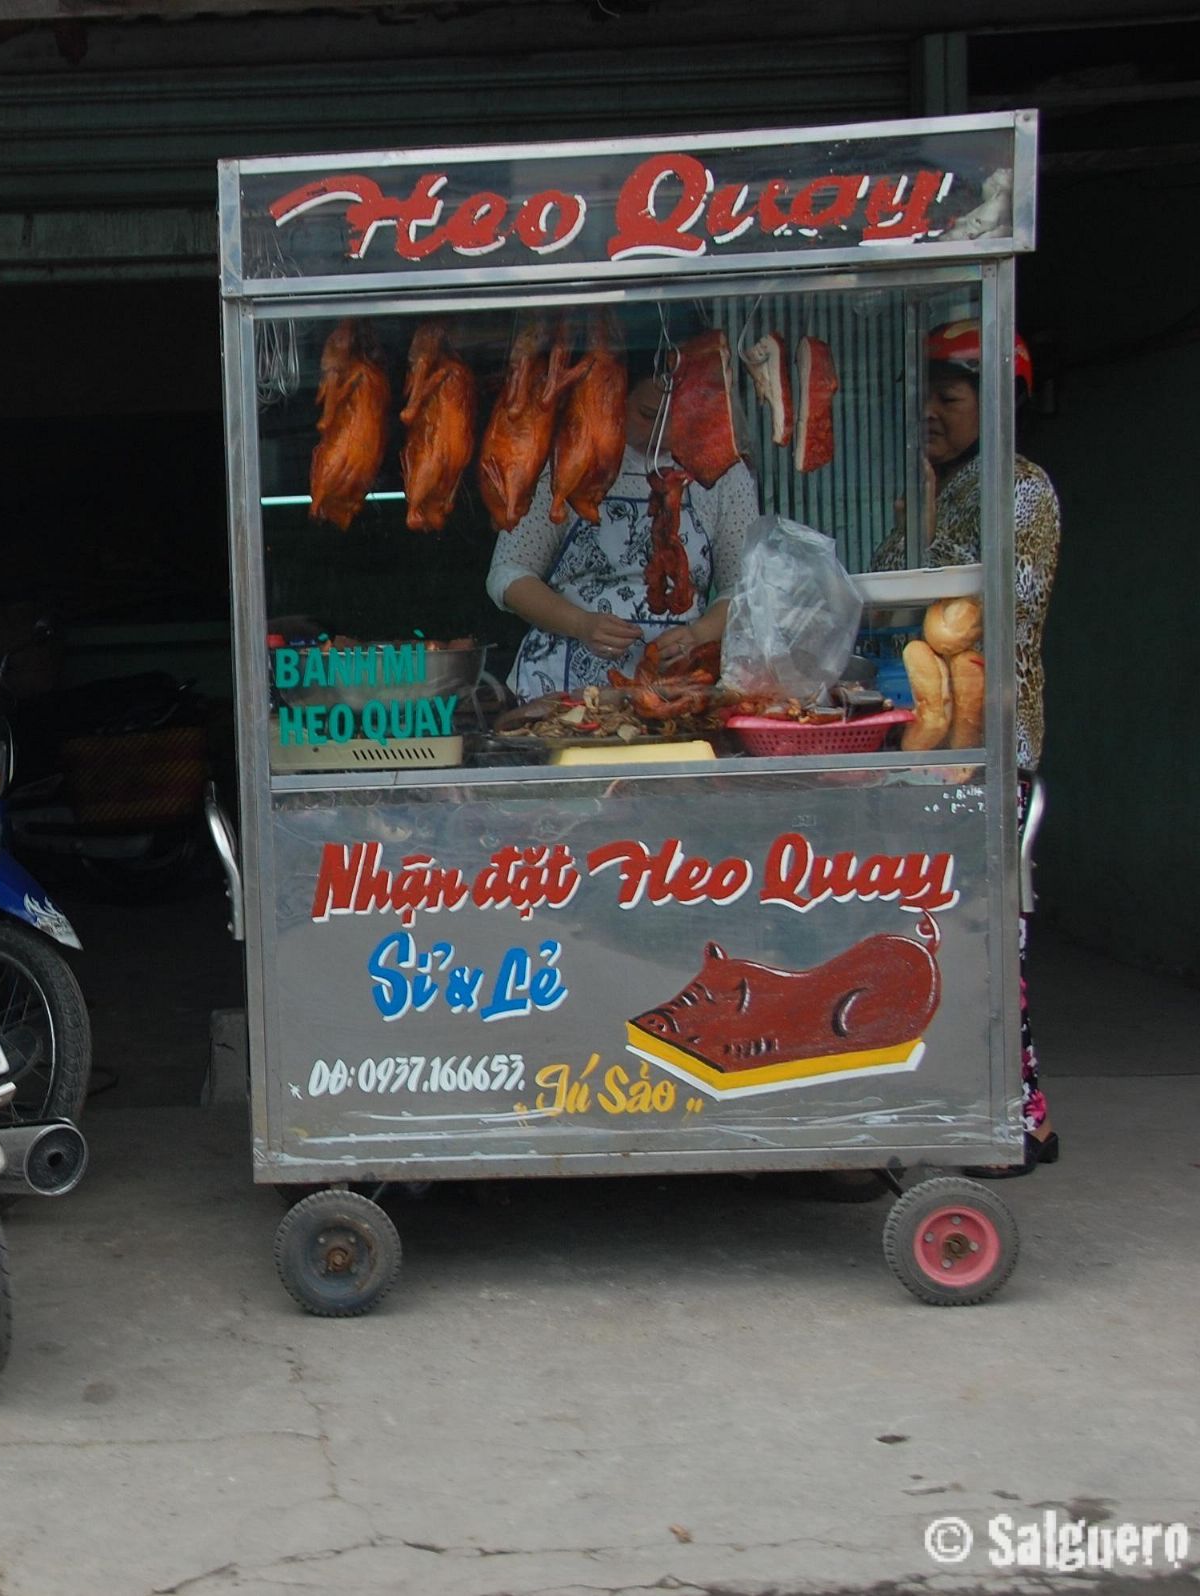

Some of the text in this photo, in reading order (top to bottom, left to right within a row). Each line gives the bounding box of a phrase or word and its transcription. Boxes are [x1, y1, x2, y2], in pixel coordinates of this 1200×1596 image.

[269, 153, 953, 262] Heo Quay
[276, 628, 426, 689] BÁNH MÌ
[279, 694, 457, 747] HEO QUAY
[311, 842, 470, 928] Nhận
[586, 838, 753, 910] Heo
[759, 832, 960, 913] Quay
[446, 966, 485, 1014] &
